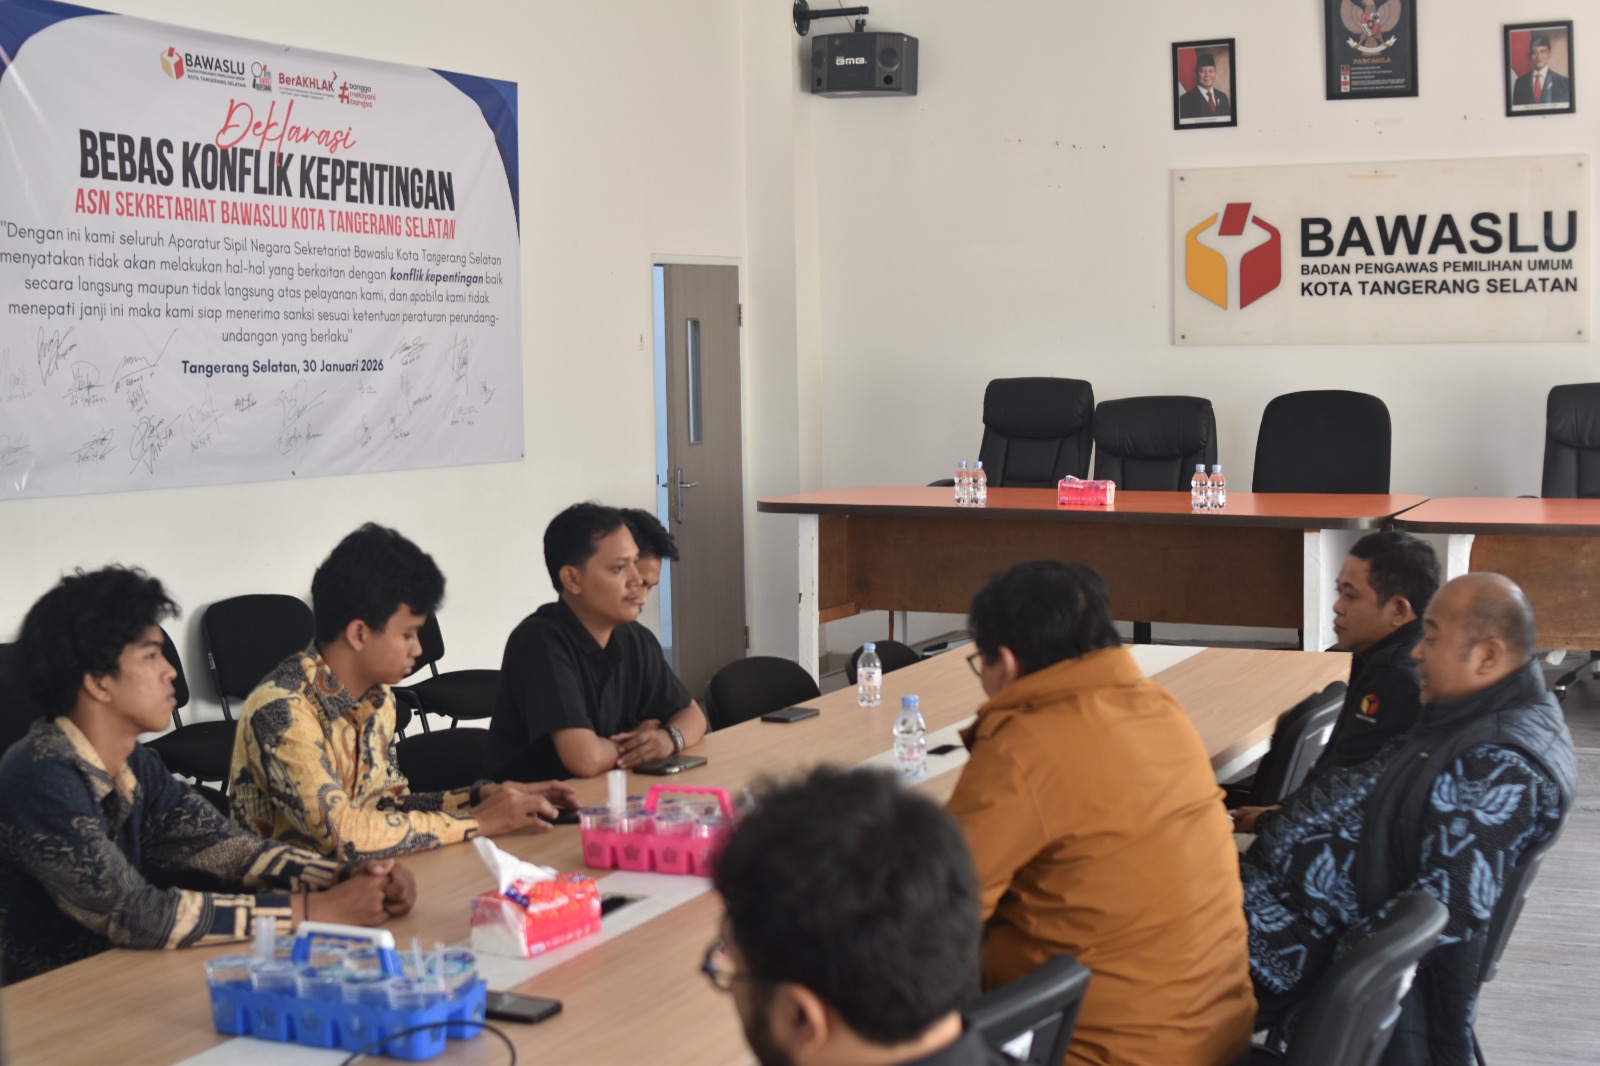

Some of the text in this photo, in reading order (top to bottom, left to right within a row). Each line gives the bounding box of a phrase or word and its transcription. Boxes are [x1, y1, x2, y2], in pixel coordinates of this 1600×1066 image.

[185, 53, 245, 76] BAWASLU
[200, 76, 227, 85] TANGERANG
[227, 80, 246, 88] SELATAN
[278, 72, 335, 92] BerAKHLAK
[350, 90, 376, 100] melayani
[215, 98, 357, 166] Deklarasi
[79, 128, 456, 212] BEBAS KONFLIK KEPENTINGAN
[75, 188, 457, 240] ASN SEKRETARIAT BAWASLU KOTA TANGERANG SELATAN
[0, 220, 502, 268] "Dengan ini kami seluruh Aparatur Sipil Negara Sekretariat Bawaslu Kota Tangerang Selatan
[1300, 210, 1578, 258] BAWASLU
[0, 250, 503, 286] menyatakan tidak akan melakukan hal-hal yang berkaitan dengan konflik kepentingan baik
[1301, 258, 1573, 276] BADAN PENGAWAS PEMILIHAN UMUM
[24, 275, 490, 306] secara langsung maupun tidak langsung atas pelayanan kami, dan apabila kami tidak
[1301, 277, 1578, 296] KOTA TANGERANG SELATAN
[8, 302, 500, 326] menepati janji ini maka kami siap menerima sanksi sesuai ketentuan peraturan perundang-
[222, 327, 352, 346] undangan yang berlaku"
[182, 359, 384, 378] Tangerang Selatan, 30 Januari 2026
